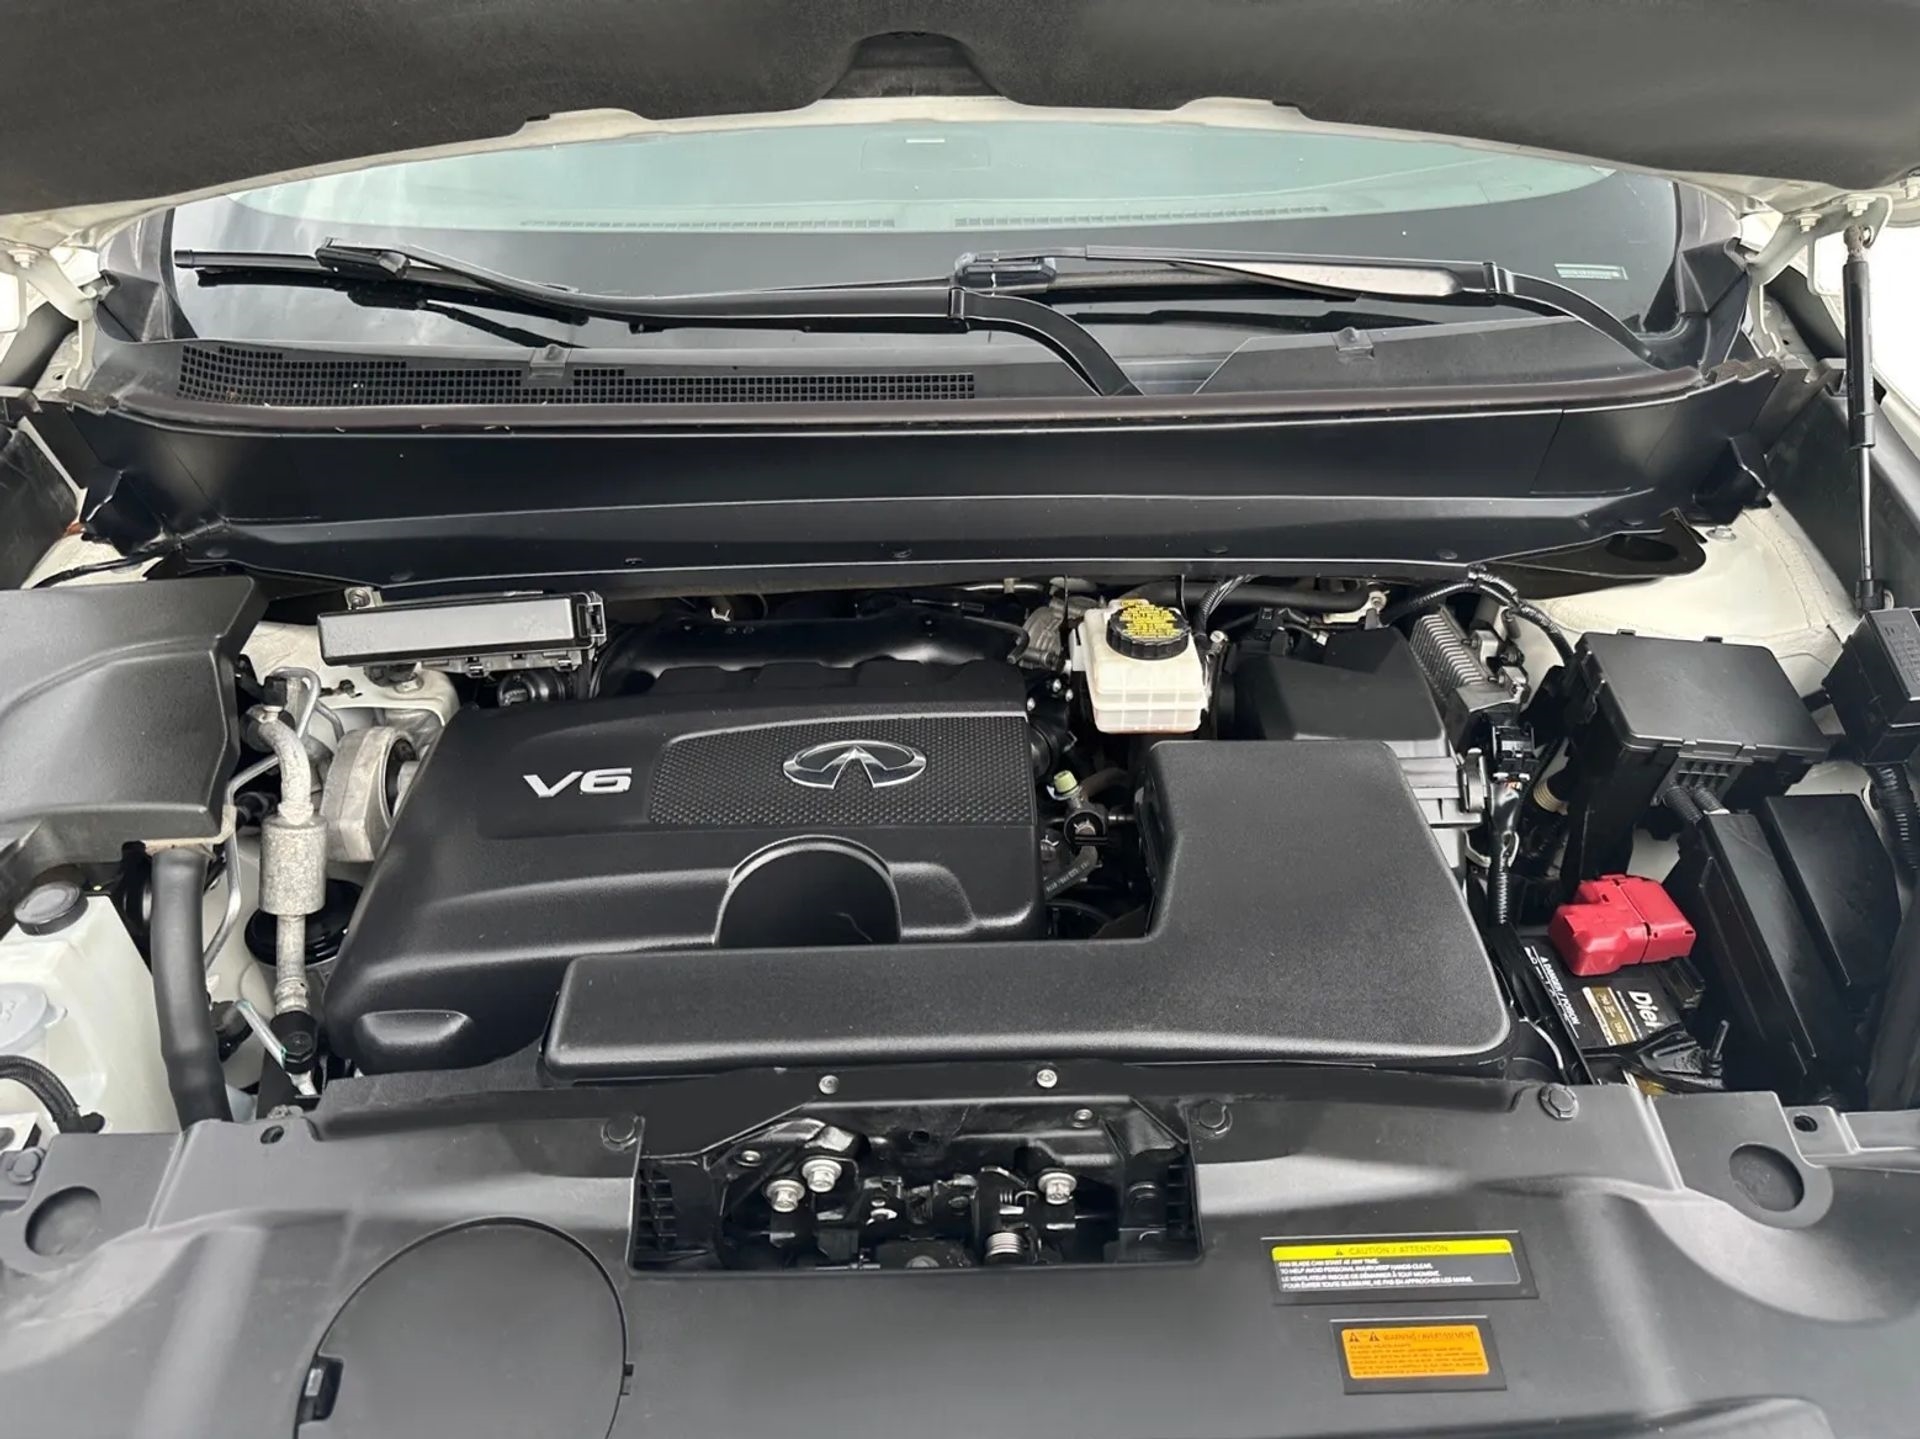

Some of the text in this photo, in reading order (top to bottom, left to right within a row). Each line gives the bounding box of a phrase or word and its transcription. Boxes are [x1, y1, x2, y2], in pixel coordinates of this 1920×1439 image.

[523, 767, 632, 798] V6
[1543, 963, 1564, 992] DANGER
[1348, 1246, 1390, 1255] CAUTION
[1399, 1244, 1449, 1253] ATTENTION
